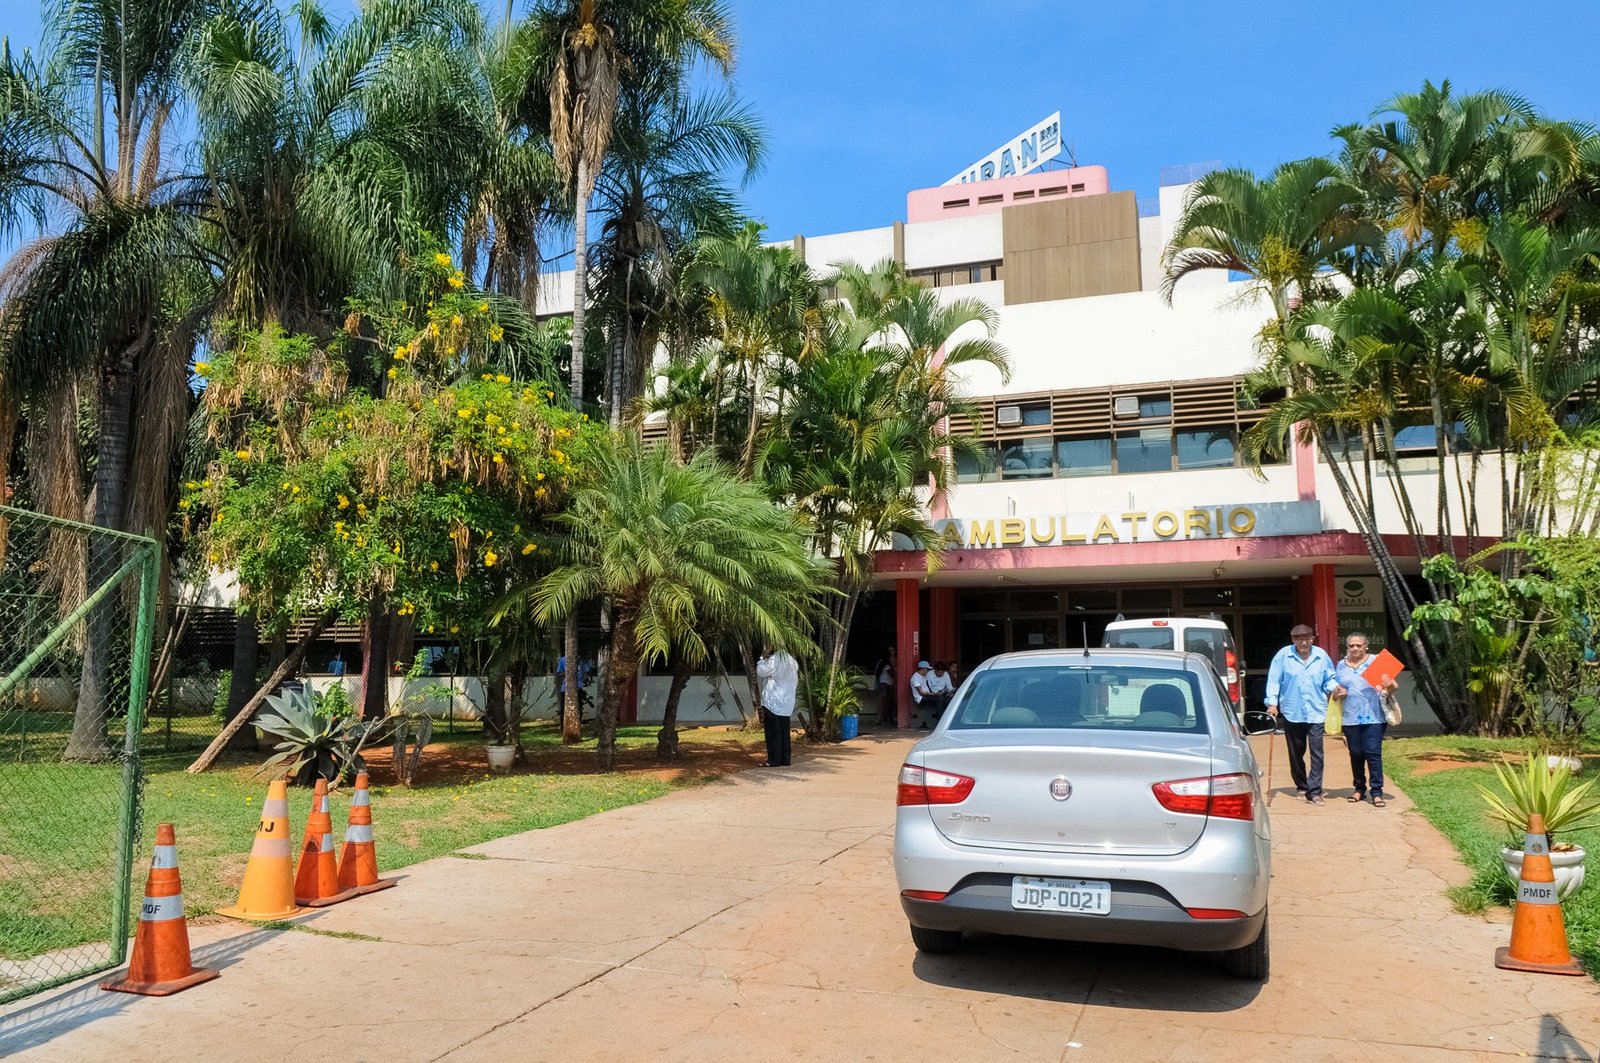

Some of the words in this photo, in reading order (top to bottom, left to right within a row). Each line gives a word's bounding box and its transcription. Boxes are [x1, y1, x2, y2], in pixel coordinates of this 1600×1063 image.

[942, 507, 1257, 546] AMBULATORIO
[1365, 616, 1375, 628] de
[1054, 783, 1068, 795] FIAT
[948, 811, 992, 824] Siena
[1523, 887, 1552, 899] PMDF
